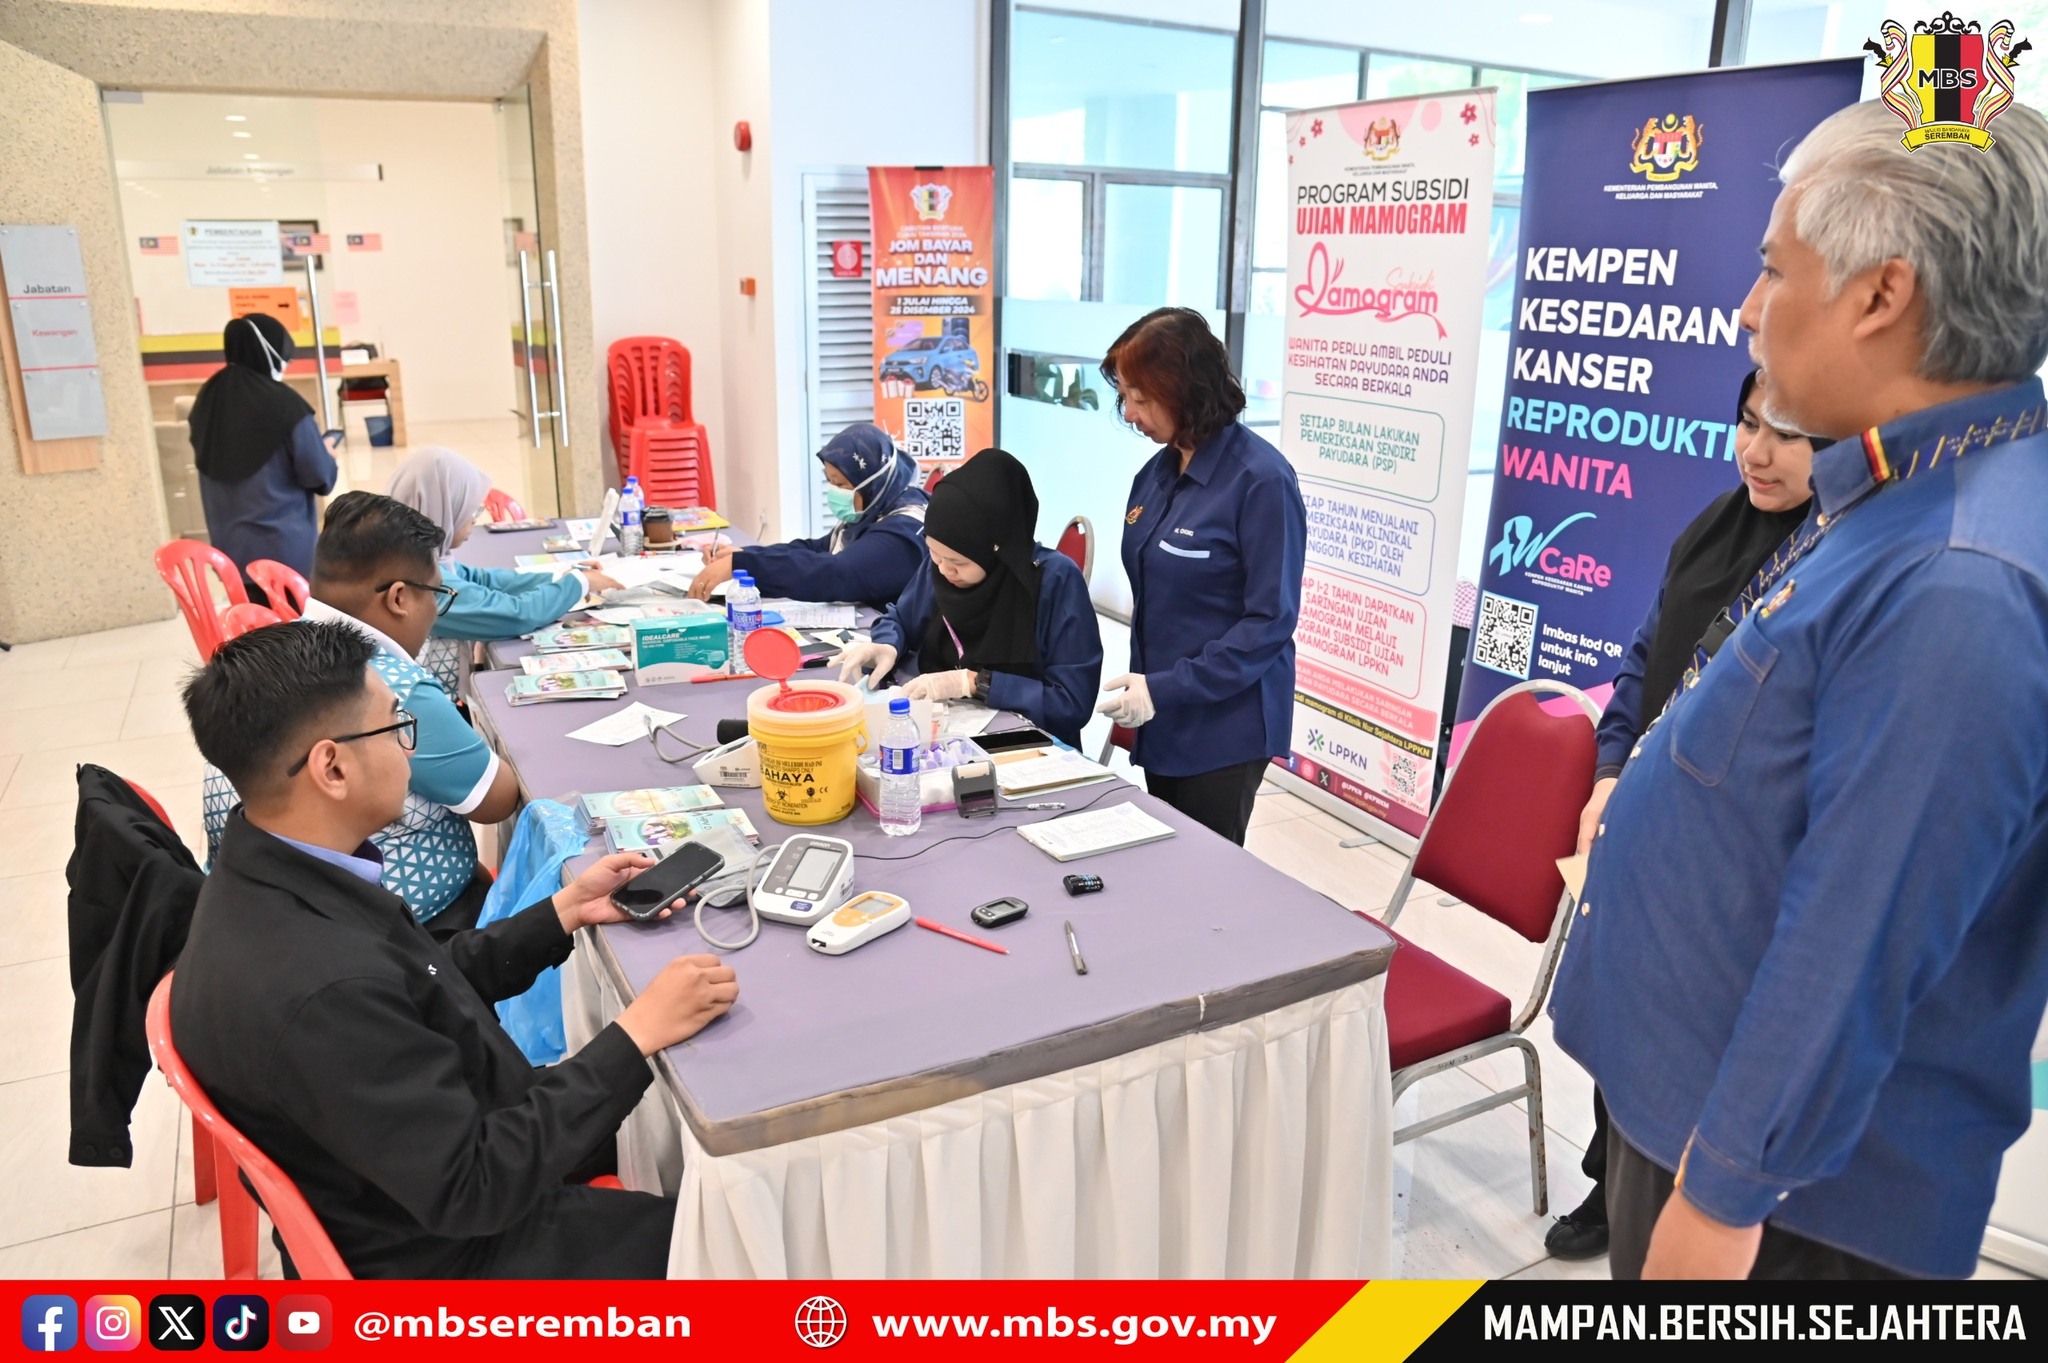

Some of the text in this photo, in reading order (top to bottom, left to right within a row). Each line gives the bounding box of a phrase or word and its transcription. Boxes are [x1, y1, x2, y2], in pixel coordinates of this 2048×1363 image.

[1298, 178, 1469, 204] PROGRAM SUBSIDI
[1604, 184, 1646, 192] KEMENTERIAN
[1296, 203, 1467, 235] UJIAN MAMOGRAM
[888, 238, 973, 253] JOM BAYAR
[914, 252, 948, 266] DAN
[876, 266, 989, 288] MENANG
[1525, 247, 1678, 286] KEMPEN
[23, 284, 72, 294] Jabatan
[1518, 298, 1740, 348] KESEDARAN
[1288, 336, 1452, 366] WANITA PERLU AMBIL PEDULI
[1288, 354, 1449, 384] KESIHATAN PAYUDARA ANDA
[1315, 372, 1412, 398] SECARA BERKALA
[1513, 348, 1653, 396] KANSER
[1300, 414, 1420, 446] SETIAP BULAN LAKUKAN
[1300, 428, 1416, 462] PEMERIKSAAN SENDIRI
[1506, 396, 1736, 462] REPRODUKTI
[1319, 446, 1398, 474] PAYUDARA (PSP)
[1502, 444, 1632, 499] WANITA
[1306, 512, 1412, 550] MERIKSAAN KLINIKAL
[1328, 500, 1358, 518] TAHUN
[1360, 508, 1418, 536] MENJALANI
[1307, 527, 1404, 563] AYUDARA (PKP) OLEH
[1308, 541, 1400, 578] NGGOTA KESIHATAN
[1306, 592, 1387, 628] SARINGAN UJIAN
[1332, 582, 1362, 606] TAHUN
[1364, 591, 1414, 624] DAPATKAN
[642, 632, 680, 641] IDEALCARE
[1298, 618, 1404, 667] OGRAM SUBSIDI UJIAN
[1302, 605, 1398, 648] AMOGRAM MELALUI
[1543, 624, 1623, 658] Imbas kod QR
[1296, 632, 1389, 677] MAMOGRAM LPPKN
[1538, 655, 1571, 676] lanjut
[1540, 642, 1598, 667] untuk info
[1338, 710, 1344, 719] di
[1344, 714, 1362, 728] Klinik
[1362, 720, 1374, 733] Nur
[1375, 726, 1402, 746] Sejahtera
[1404, 740, 1430, 758] LPPKN
[1329, 741, 1368, 770] LPPKN
